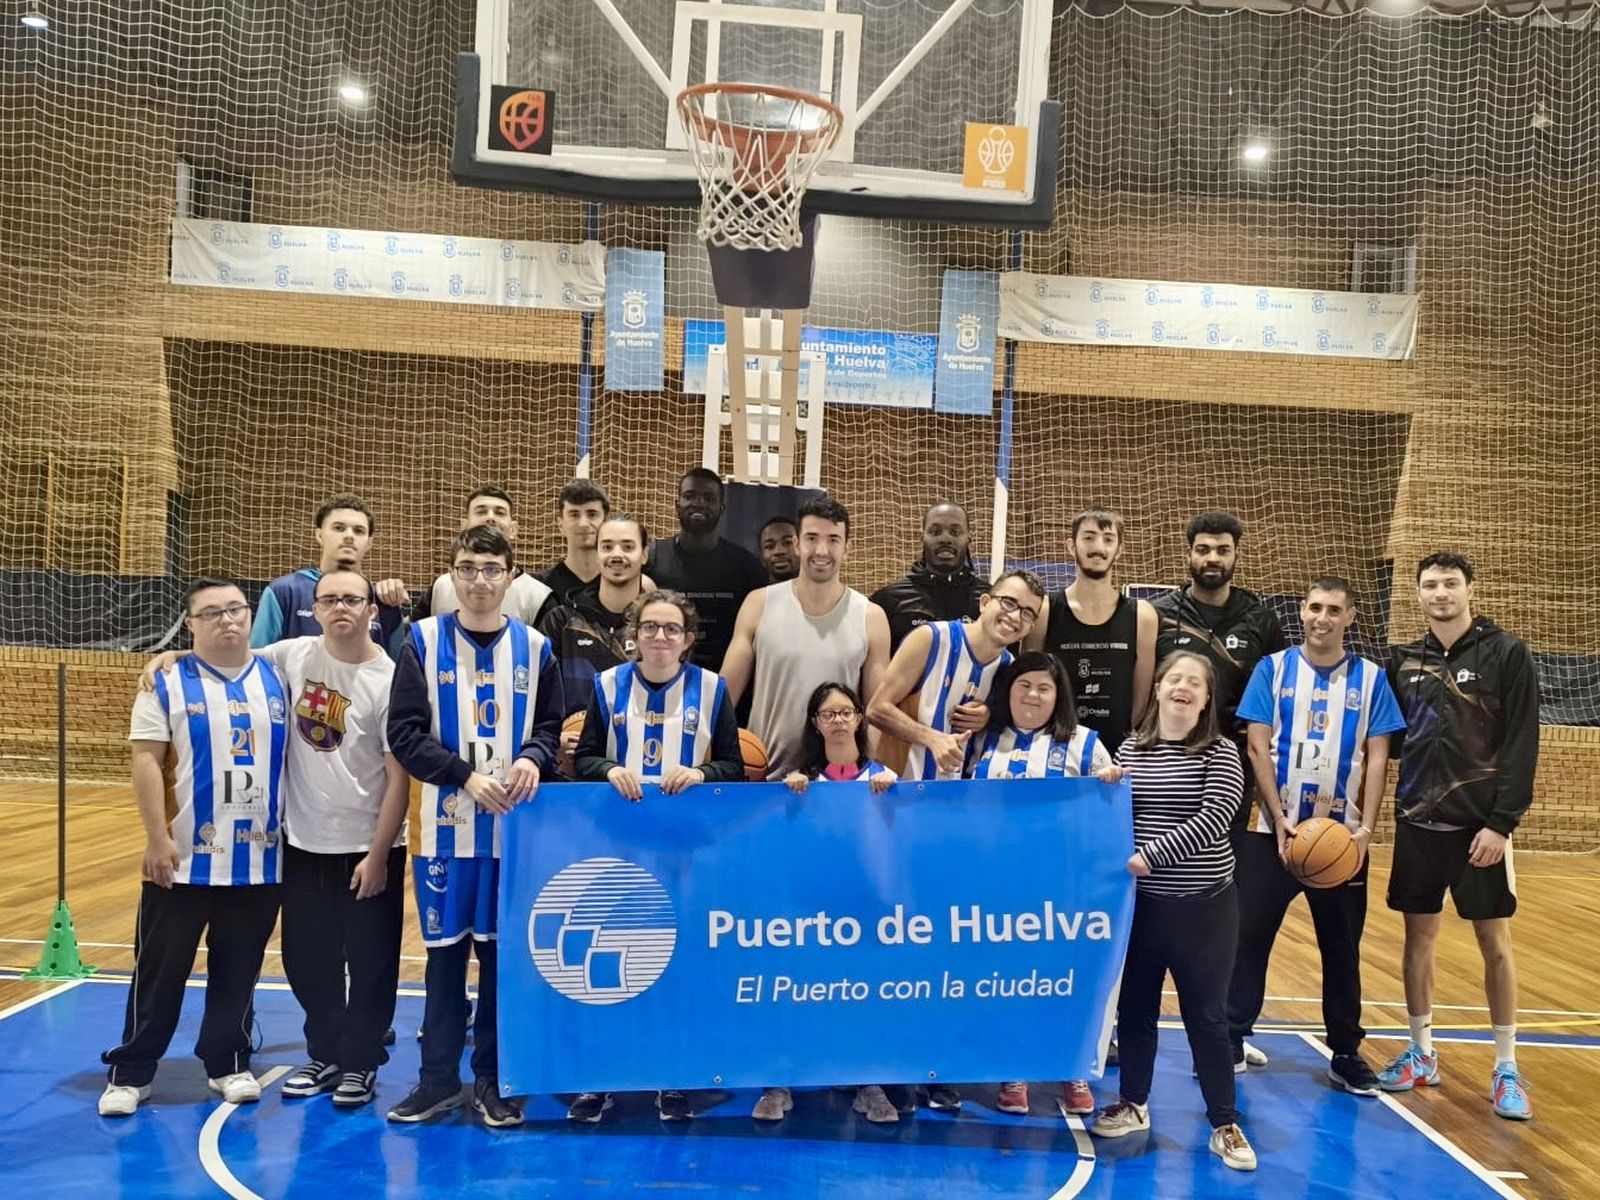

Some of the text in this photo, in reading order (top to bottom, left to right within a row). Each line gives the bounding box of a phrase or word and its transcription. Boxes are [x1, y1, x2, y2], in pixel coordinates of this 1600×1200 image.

[834, 355, 888, 369] Huelva
[471, 699, 501, 728] 10
[1305, 711, 1330, 733] 19
[229, 727, 256, 756] 21
[643, 738, 663, 767] 9
[709, 901, 1111, 947] Puerto de Huelva
[736, 969, 1073, 1002] El Puerto con la ciudad
